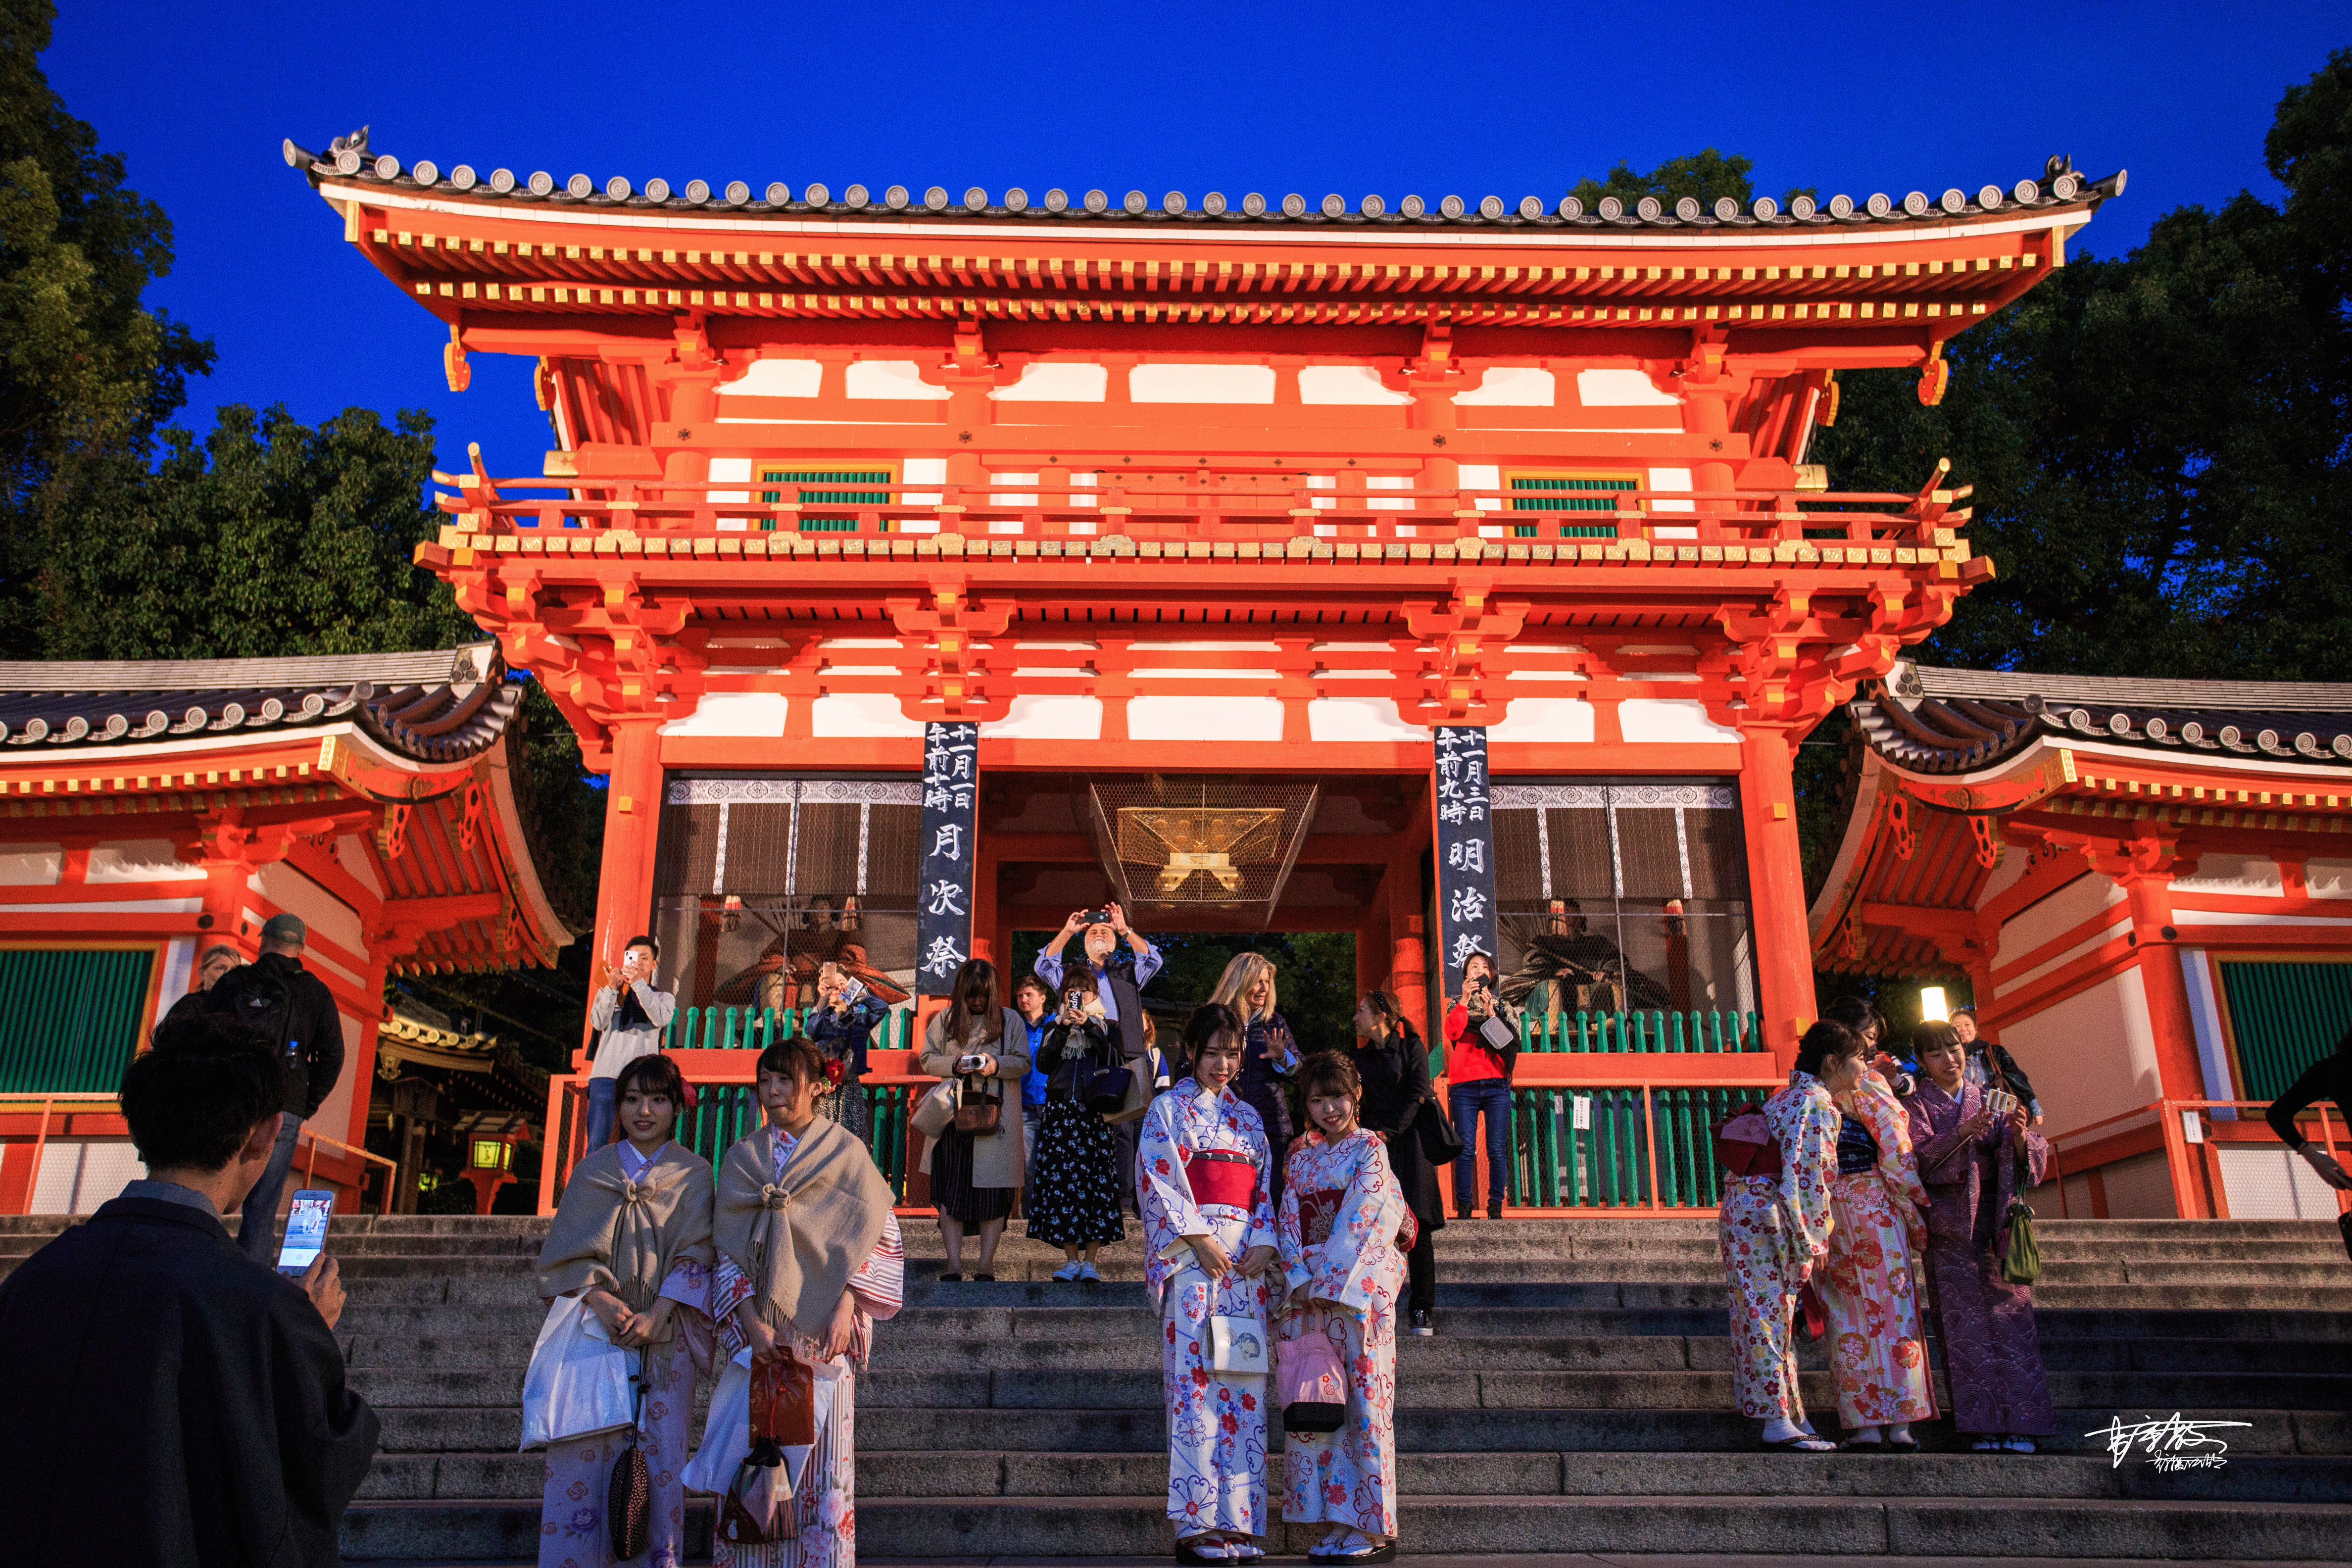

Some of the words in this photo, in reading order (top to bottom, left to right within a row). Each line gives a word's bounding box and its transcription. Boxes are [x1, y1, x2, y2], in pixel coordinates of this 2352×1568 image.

[924, 722, 953, 813] 午前十時
[949, 724, 977, 810] 十一月一日
[1436, 727, 1469, 827] 午前九時
[1460, 729, 1489, 822] 十一月三日
[920, 823, 967, 979] 月次祭
[1448, 838, 1493, 971] 明治祭
[1070, 992, 1080, 1010] Supr
